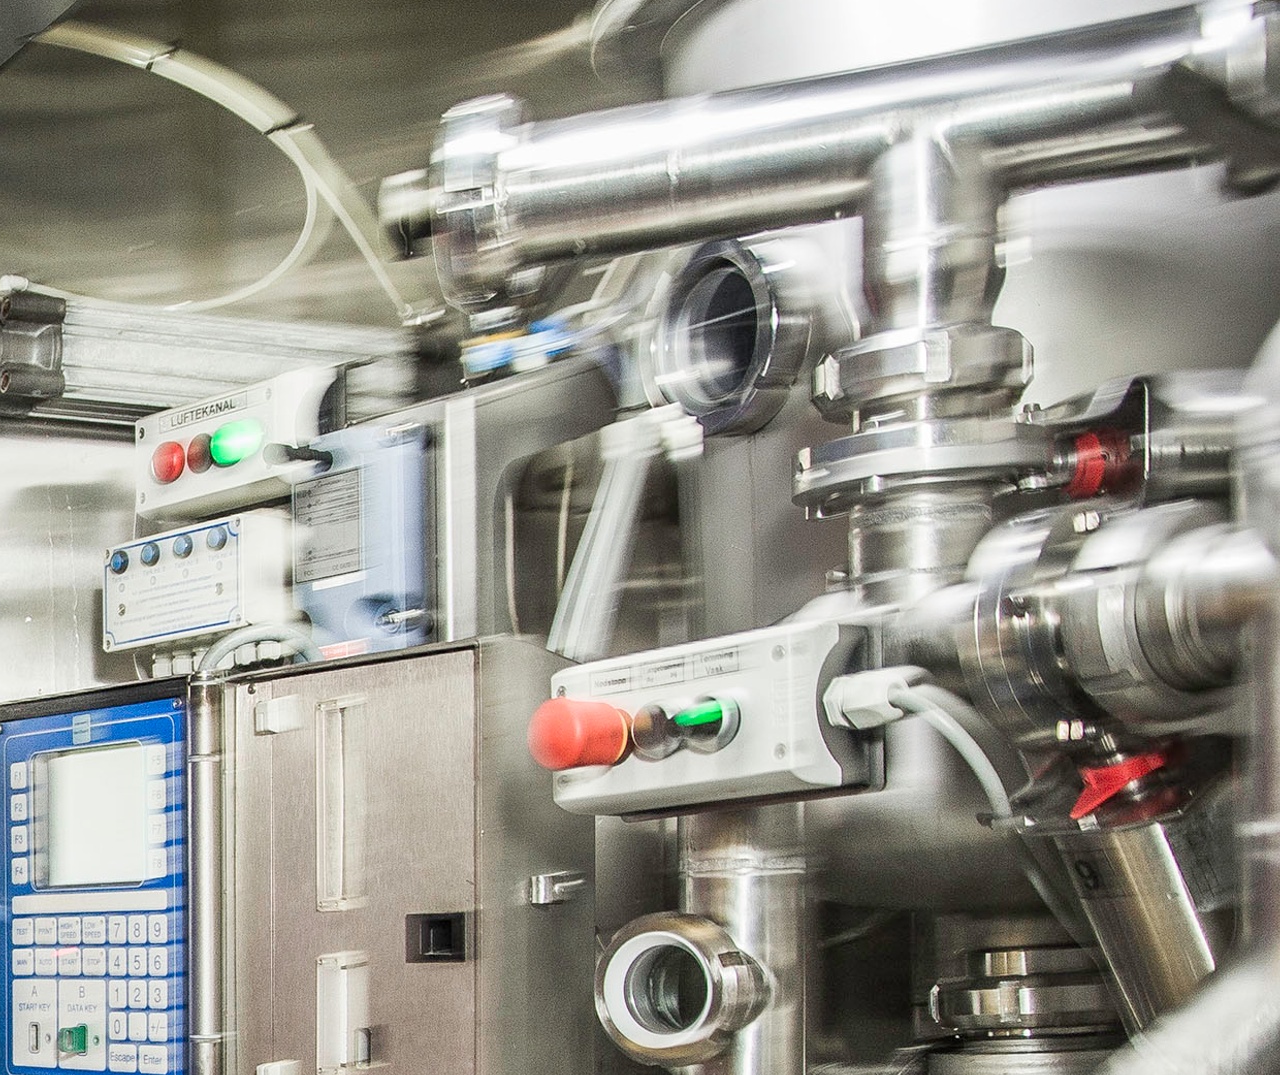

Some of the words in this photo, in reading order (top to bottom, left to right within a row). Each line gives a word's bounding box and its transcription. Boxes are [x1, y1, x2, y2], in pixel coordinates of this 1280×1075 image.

[170, 399, 236, 428] LUFTEKANAL
[152, 754, 161, 767] F5
[14, 770, 22, 781] F1
[14, 802, 23, 813] F2
[152, 823, 162, 836] F7
[14, 834, 23, 845] F3
[152, 857, 162, 870] F8
[14, 865, 24, 876] F4
[16, 927, 28, 935] TEST
[84, 921, 96, 930] LOW
[114, 922, 121, 938] 7
[133, 922, 141, 938] 8
[153, 921, 162, 938] 9
[84, 930, 102, 938] SPEED
[60, 958, 78, 967] START
[86, 958, 101, 967] STOP
[114, 955, 121, 970] 4
[133, 954, 141, 971] 5
[153, 954, 162, 971] 6
[30, 985, 39, 998] A
[78, 985, 86, 999] B
[114, 987, 121, 1002] 1
[133, 987, 142, 1003] 2
[153, 987, 162, 1003] 3
[18, 1002, 38, 1012] START
[39, 1002, 52, 1012] KEY
[67, 1003, 84, 1013] DATA
[85, 1003, 97, 1013] KEY
[113, 1018, 121, 1035] 0
[110, 1051, 136, 1064] Escape
[143, 1053, 163, 1065] Enter
